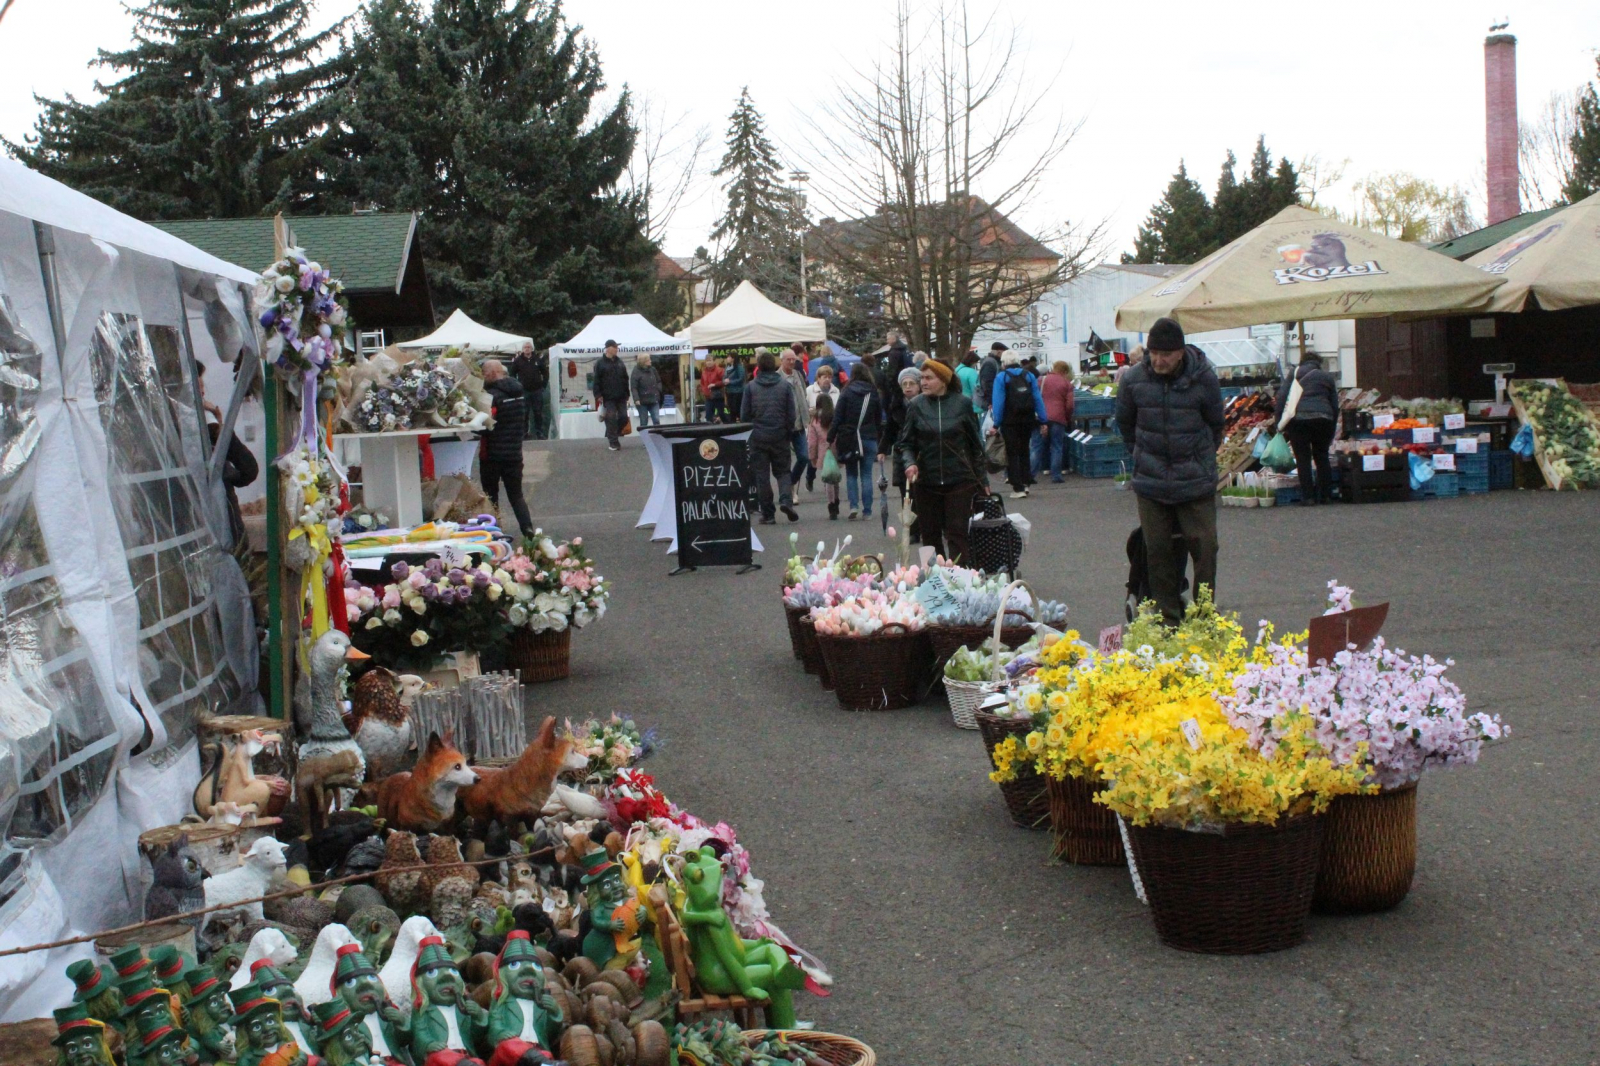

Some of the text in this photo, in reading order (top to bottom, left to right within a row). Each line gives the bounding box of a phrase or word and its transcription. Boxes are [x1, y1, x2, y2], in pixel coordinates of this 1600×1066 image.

[1272, 259, 1388, 286] Kozel
[562, 342, 692, 354] www.zahrnihadicenavodu.cz
[711, 346, 756, 357] MASOŽRA
[683, 464, 742, 488] PIZZA
[681, 493, 749, 523] PALAČINKA
